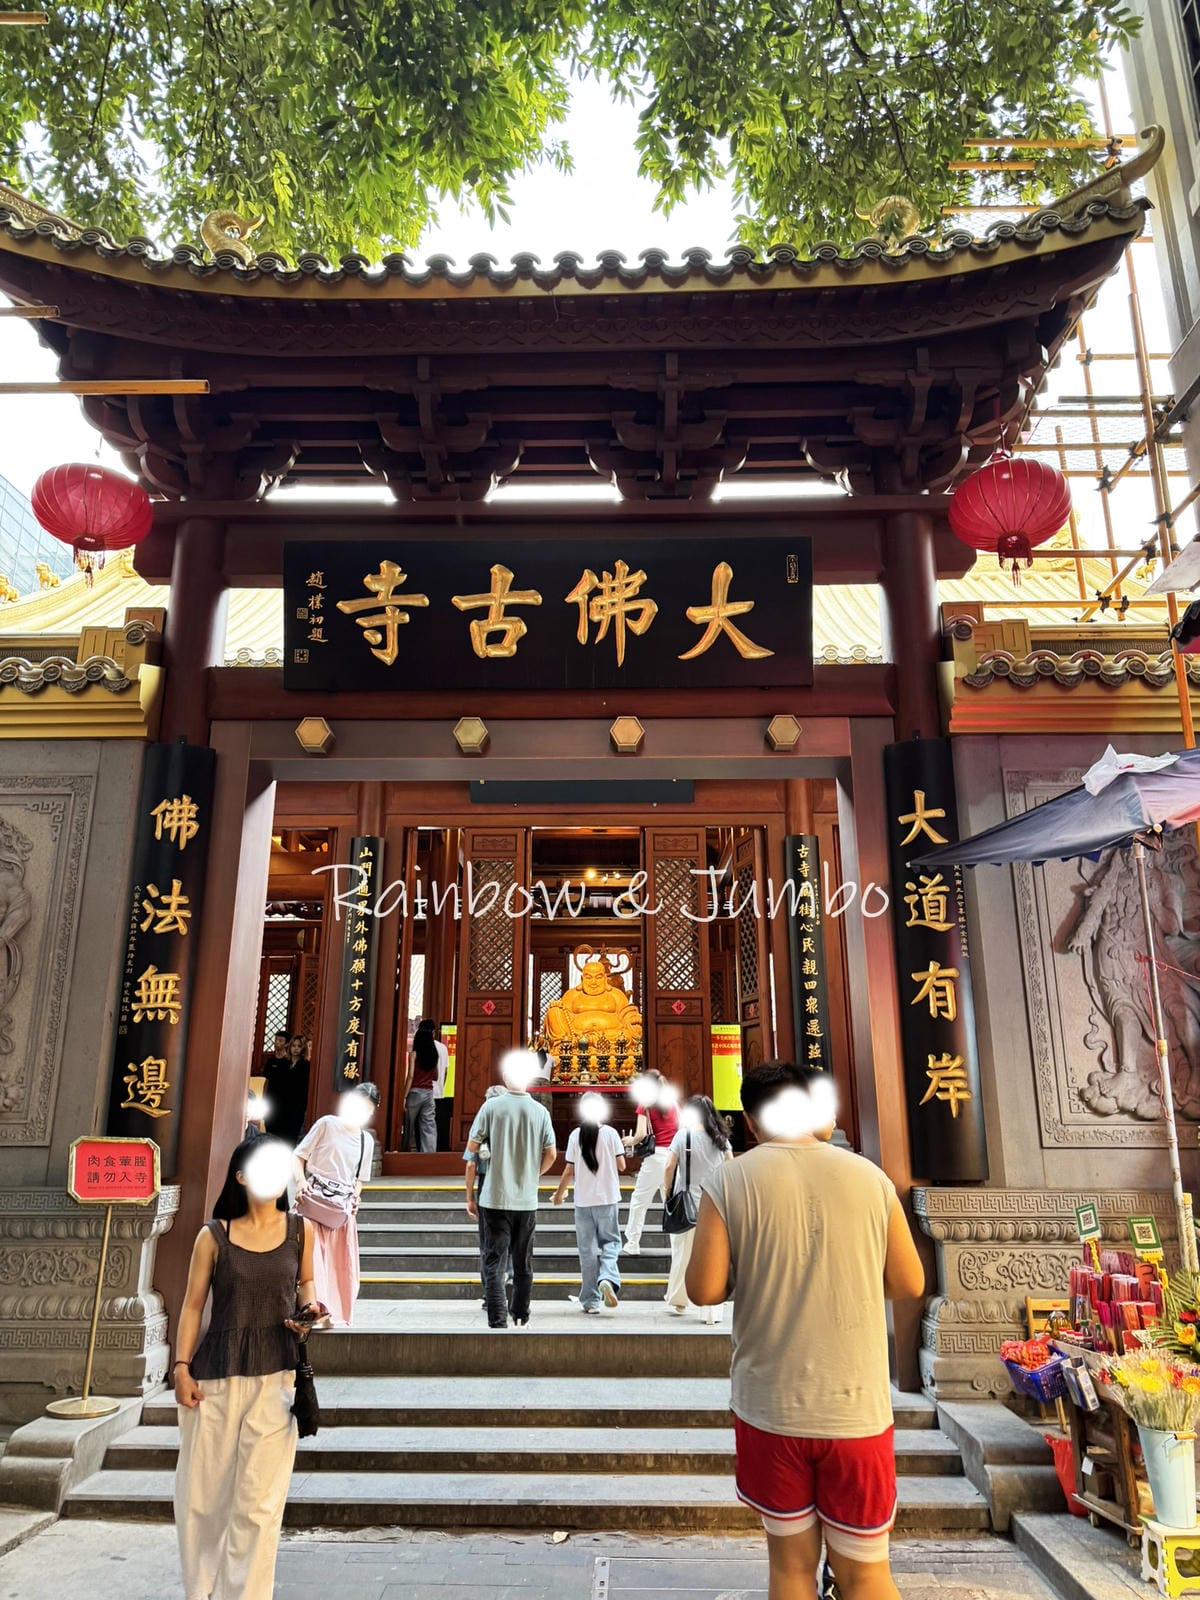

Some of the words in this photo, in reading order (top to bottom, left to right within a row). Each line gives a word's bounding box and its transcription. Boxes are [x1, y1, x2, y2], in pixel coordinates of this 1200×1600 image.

[336, 559, 775, 667] 大佛古寺
[121, 794, 200, 1119] 佛法無邊
[898, 789, 972, 1119] 大道有岸
[87, 1155, 147, 1167] 肉食葷腥
[87, 1171, 147, 1184] 請勿入寺
